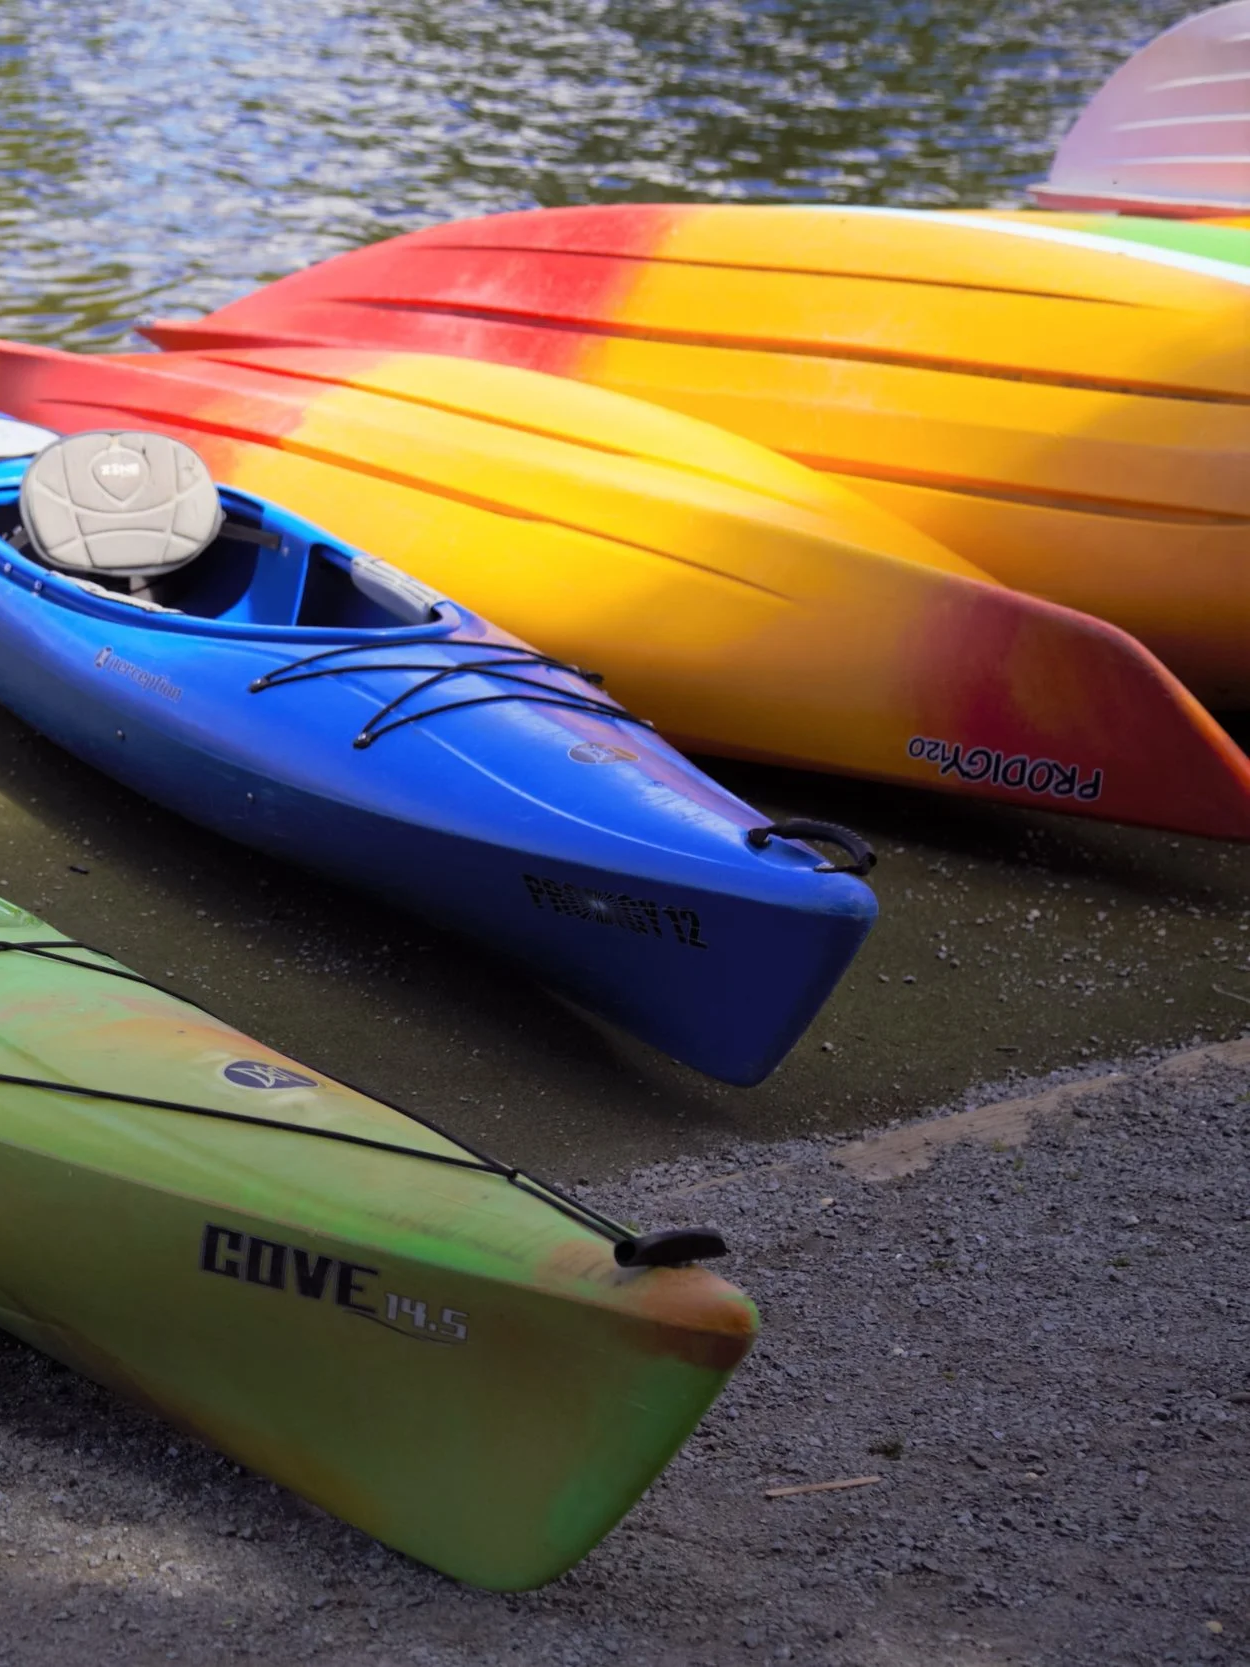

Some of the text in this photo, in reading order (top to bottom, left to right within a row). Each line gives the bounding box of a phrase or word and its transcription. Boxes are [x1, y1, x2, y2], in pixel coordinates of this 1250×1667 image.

[662, 906, 708, 949] 12
[201, 1223, 469, 1341] COVE 14.5
